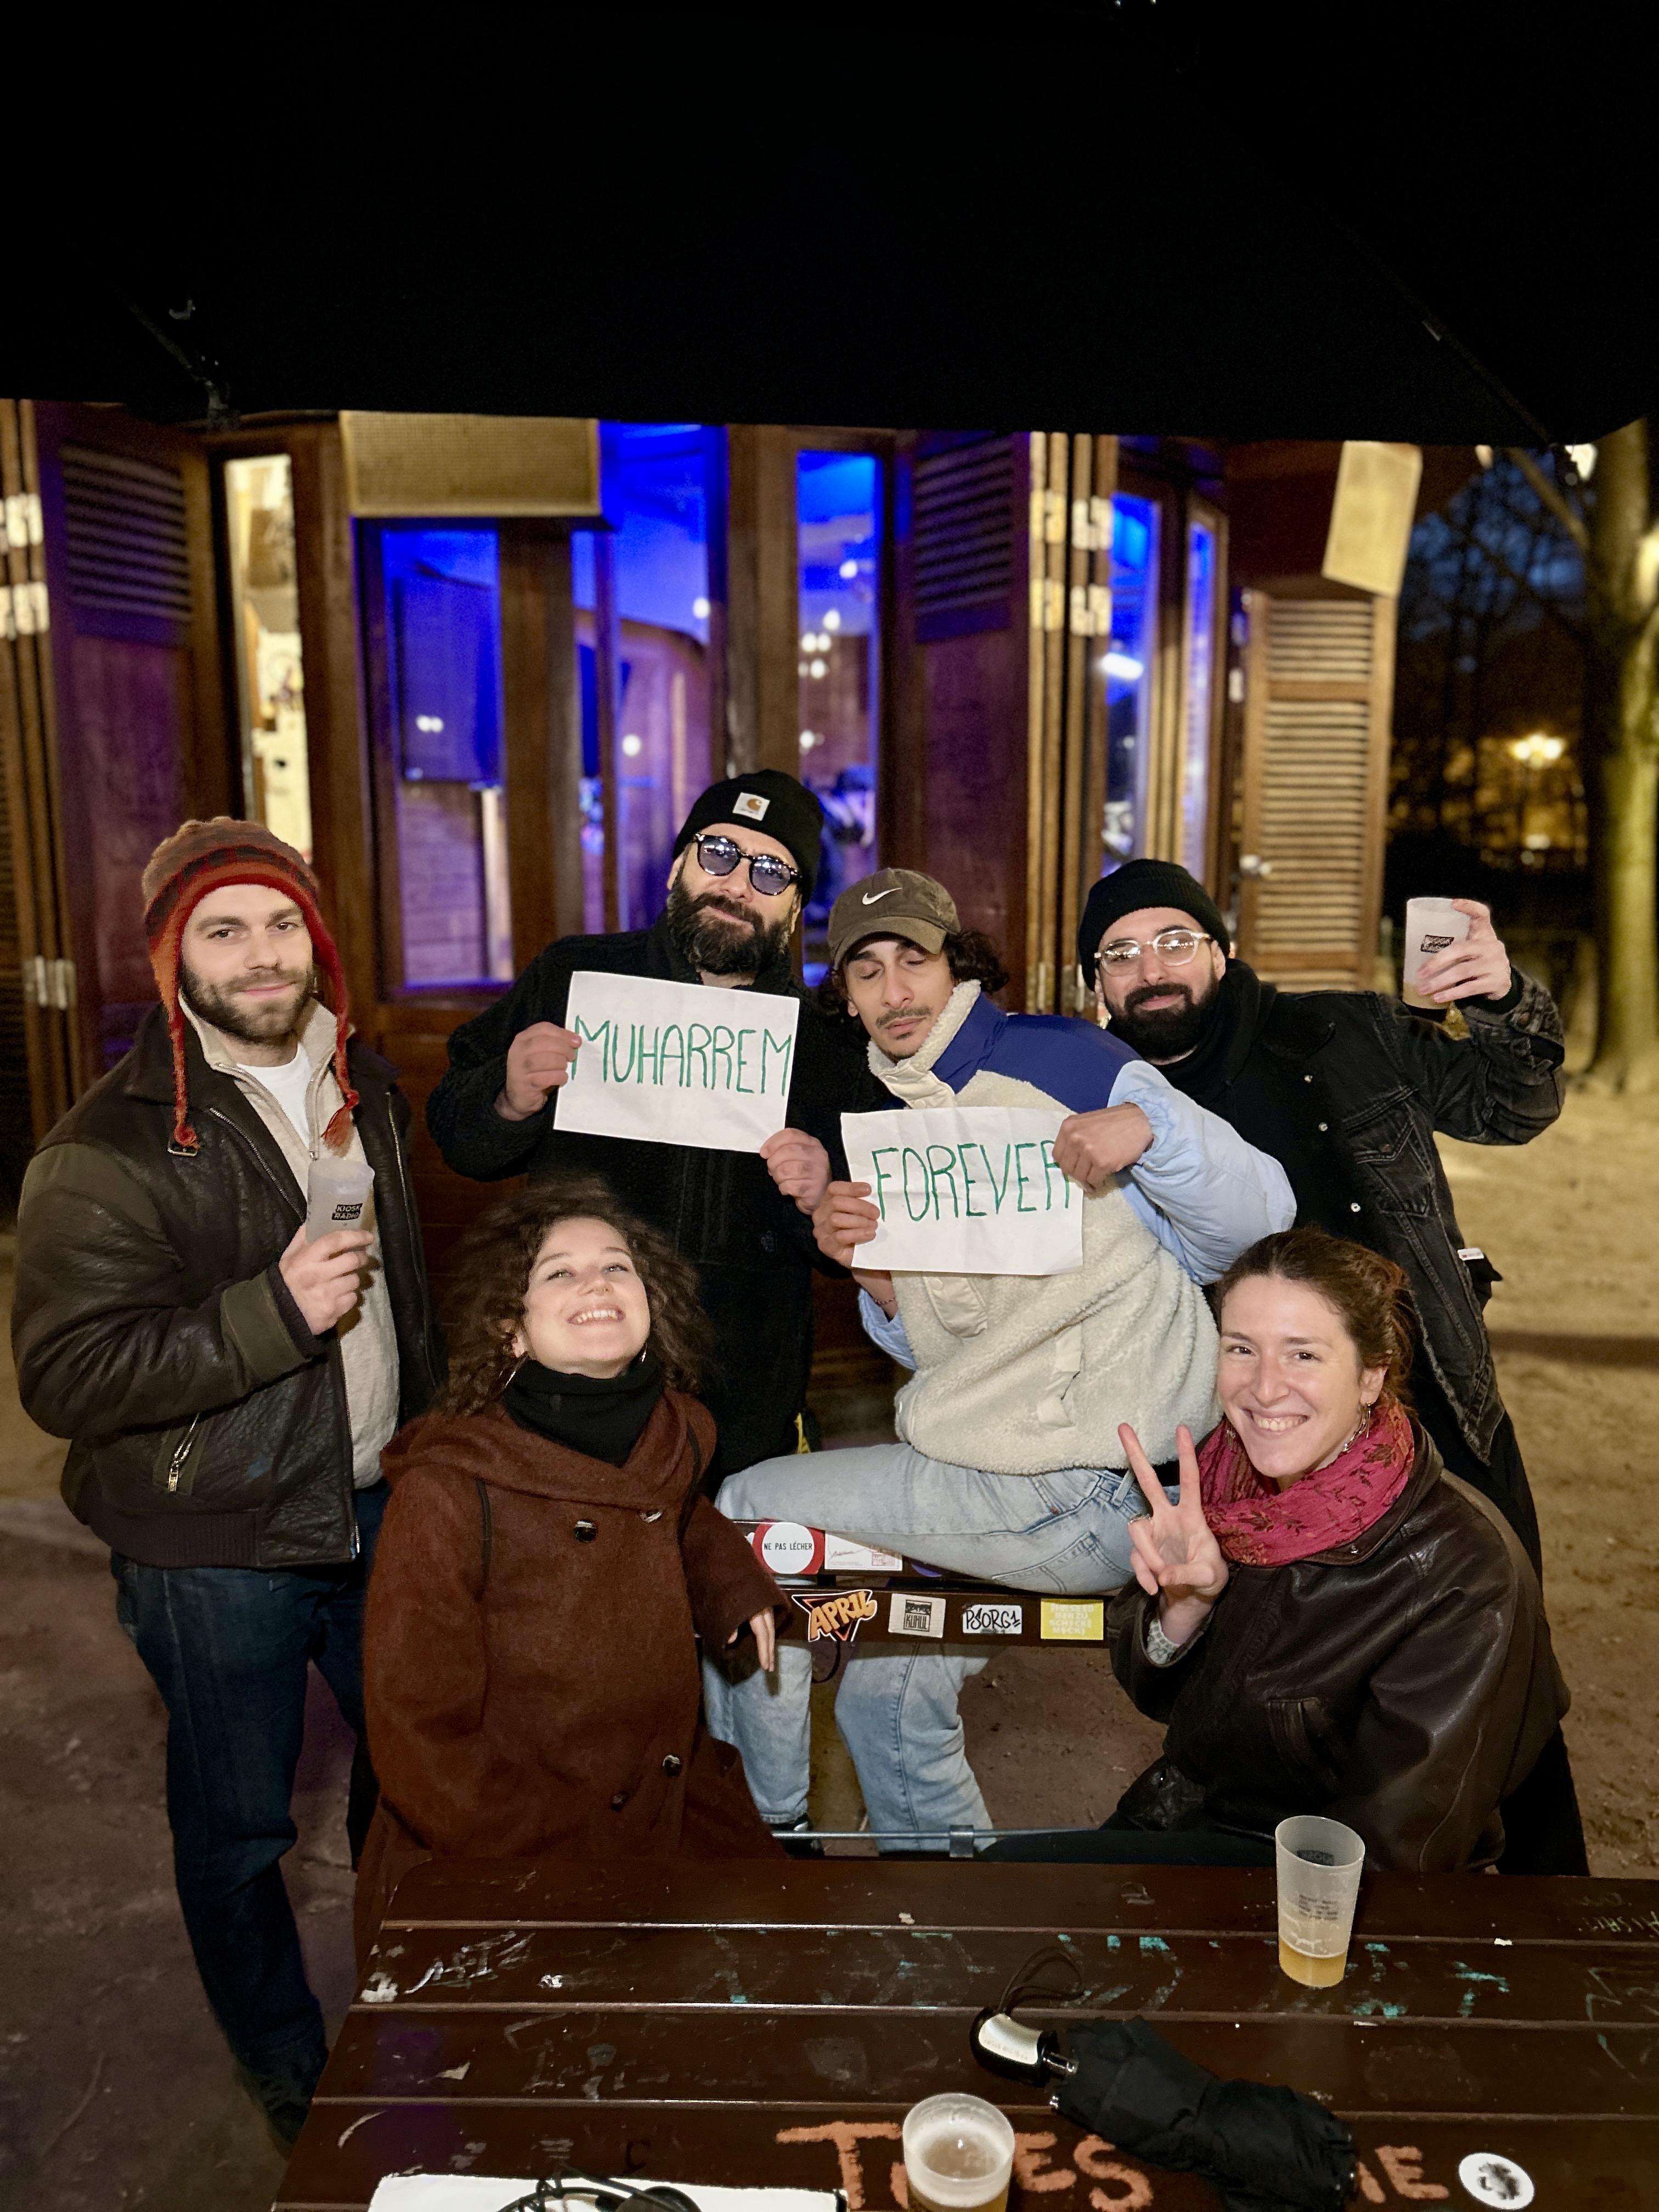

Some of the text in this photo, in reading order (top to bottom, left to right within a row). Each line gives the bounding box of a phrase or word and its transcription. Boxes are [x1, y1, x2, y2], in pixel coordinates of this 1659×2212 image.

[571, 1015, 792, 1096] MUHARREM
[872, 1140, 1070, 1222] FOREVER
[789, 1541, 812, 1550] LÉCHER
[810, 1591, 876, 1639] APRIL
